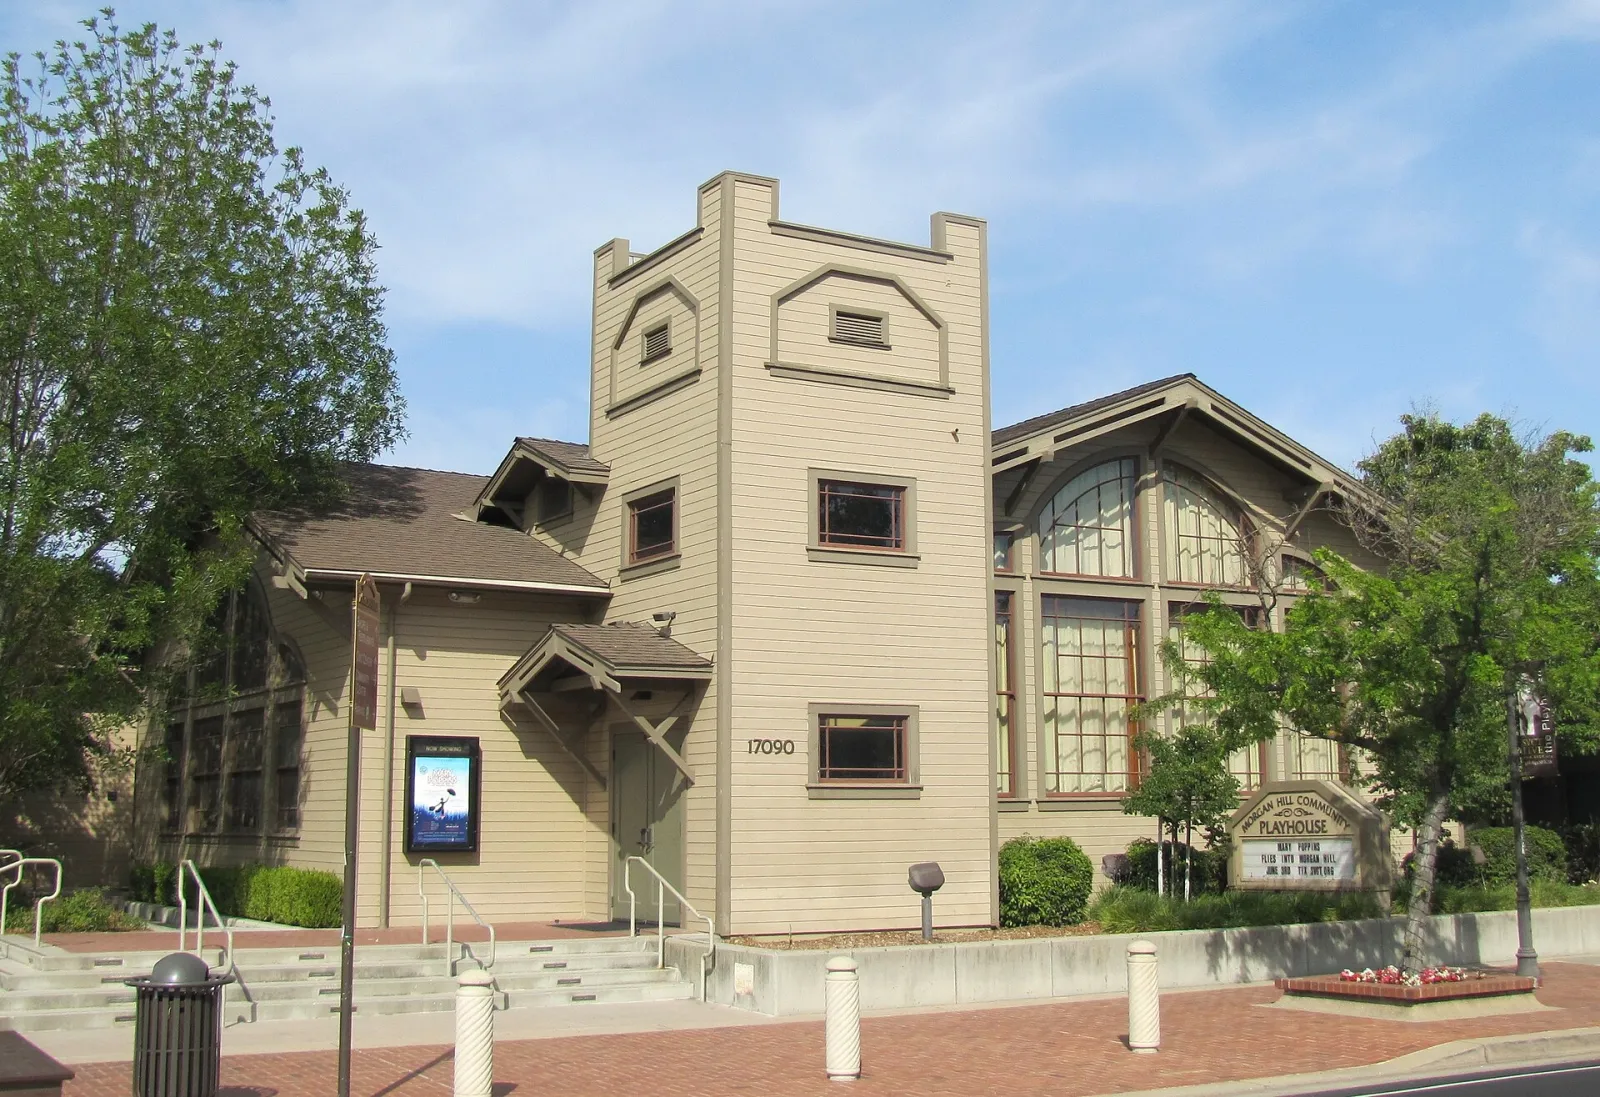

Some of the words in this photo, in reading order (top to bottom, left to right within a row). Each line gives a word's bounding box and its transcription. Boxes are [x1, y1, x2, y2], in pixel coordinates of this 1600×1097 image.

[748, 739, 795, 755] 17090
[1544, 735, 1553, 754] the
[1241, 800, 1274, 833] MORGAN
[1276, 796, 1294, 807] HILL
[1297, 795, 1350, 831] COMMUNITY
[1259, 820, 1328, 834] PLAYHOUSE
[1277, 842, 1292, 852] MARY
[1298, 842, 1320, 852] POPPINS
[1261, 854, 1277, 864] FLIES
[1281, 854, 1294, 864] INTO
[1299, 854, 1320, 863] MORGAN
[1323, 854, 1336, 863] HILL
[1266, 866, 1278, 875] JUNE
[1281, 866, 1291, 875] 3RD
